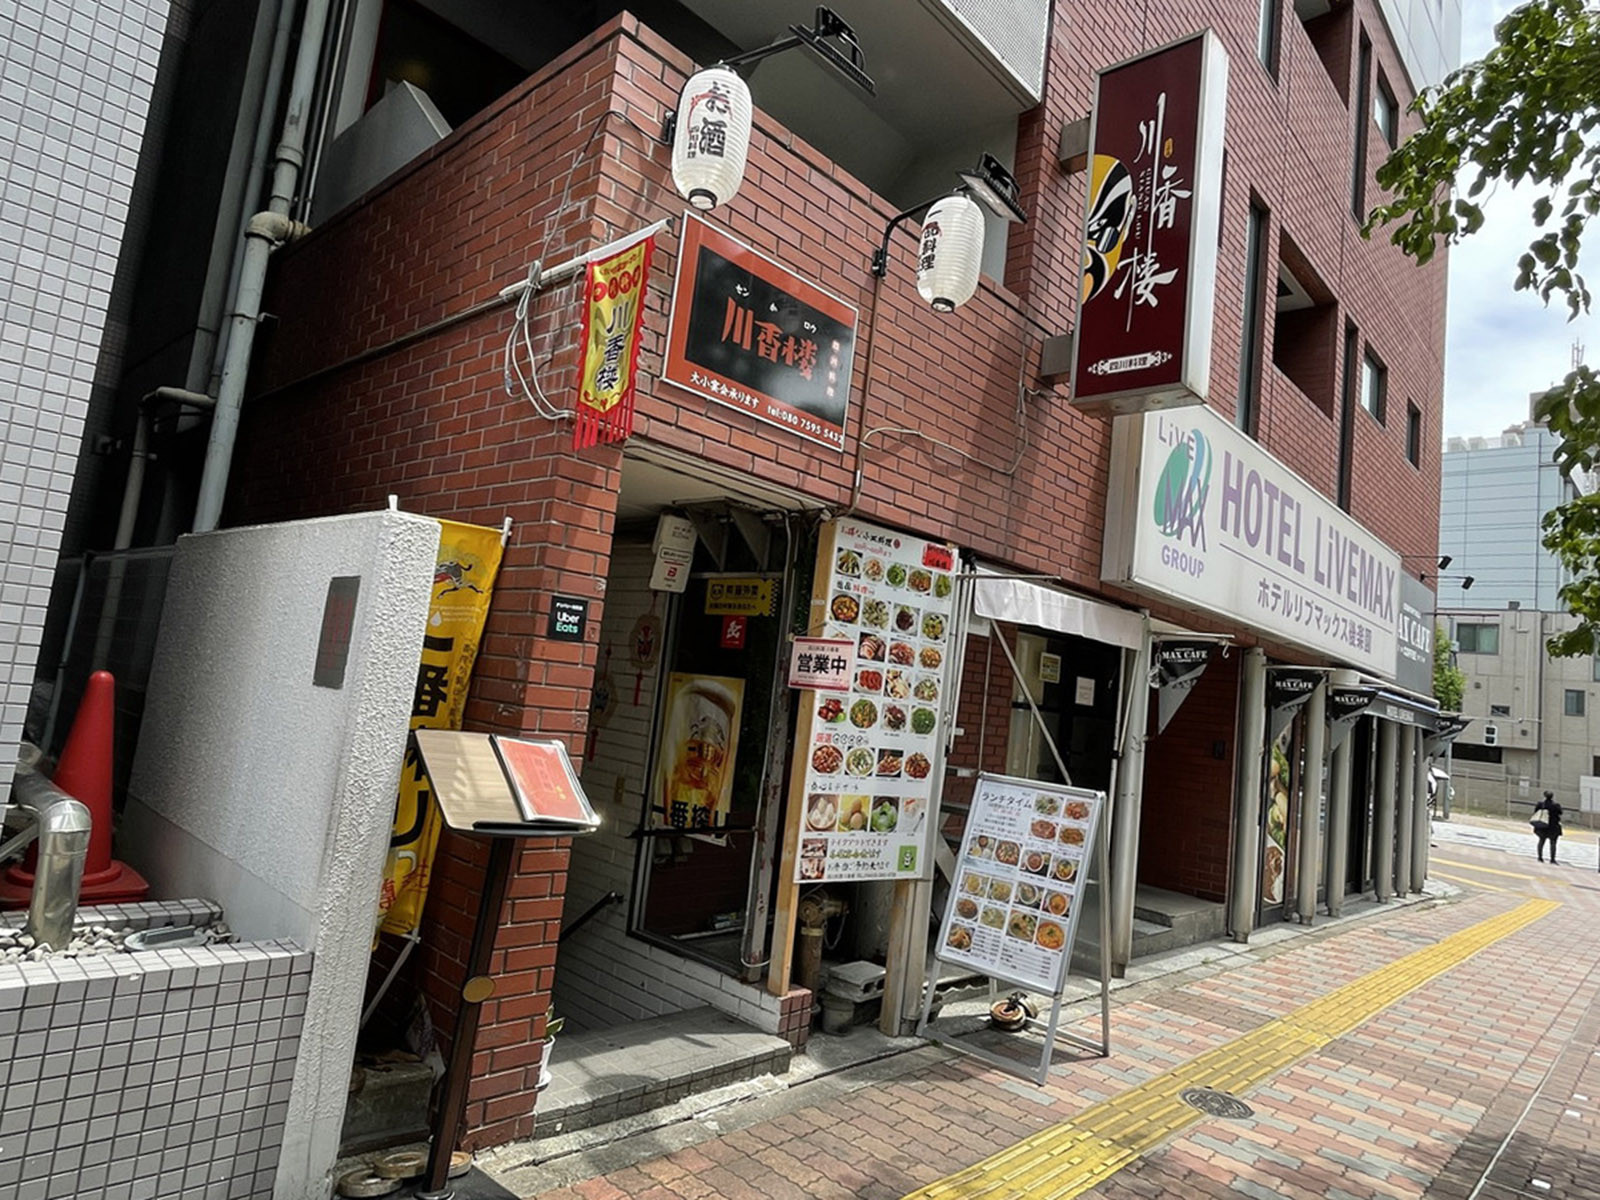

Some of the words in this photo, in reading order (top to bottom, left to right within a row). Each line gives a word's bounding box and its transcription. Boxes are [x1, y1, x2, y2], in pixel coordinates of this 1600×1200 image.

[1113, 92, 1192, 333] 川香楼
[921, 209, 942, 271] 一品料理
[595, 301, 630, 391] 川香楼
[721, 296, 818, 382] 川香楼
[690, 371, 760, 409] 大小宴会承ります
[1220, 450, 1305, 575] HOTEL
[1314, 516, 1396, 624] LiVEMAX
[1161, 544, 1205, 579] GROUP
[555, 621, 579, 634] Eats
[556, 611, 580, 624] Uber
[797, 652, 847, 676] 営業中
[1161, 650, 1182, 660] MAX
[1183, 649, 1208, 659] CAFE
[1275, 680, 1292, 688] MAX
[1292, 681, 1314, 689] CAFE
[1334, 695, 1350, 703] MAX
[1350, 695, 1369, 703] CAFE
[981, 791, 1033, 809] ランチタイム
